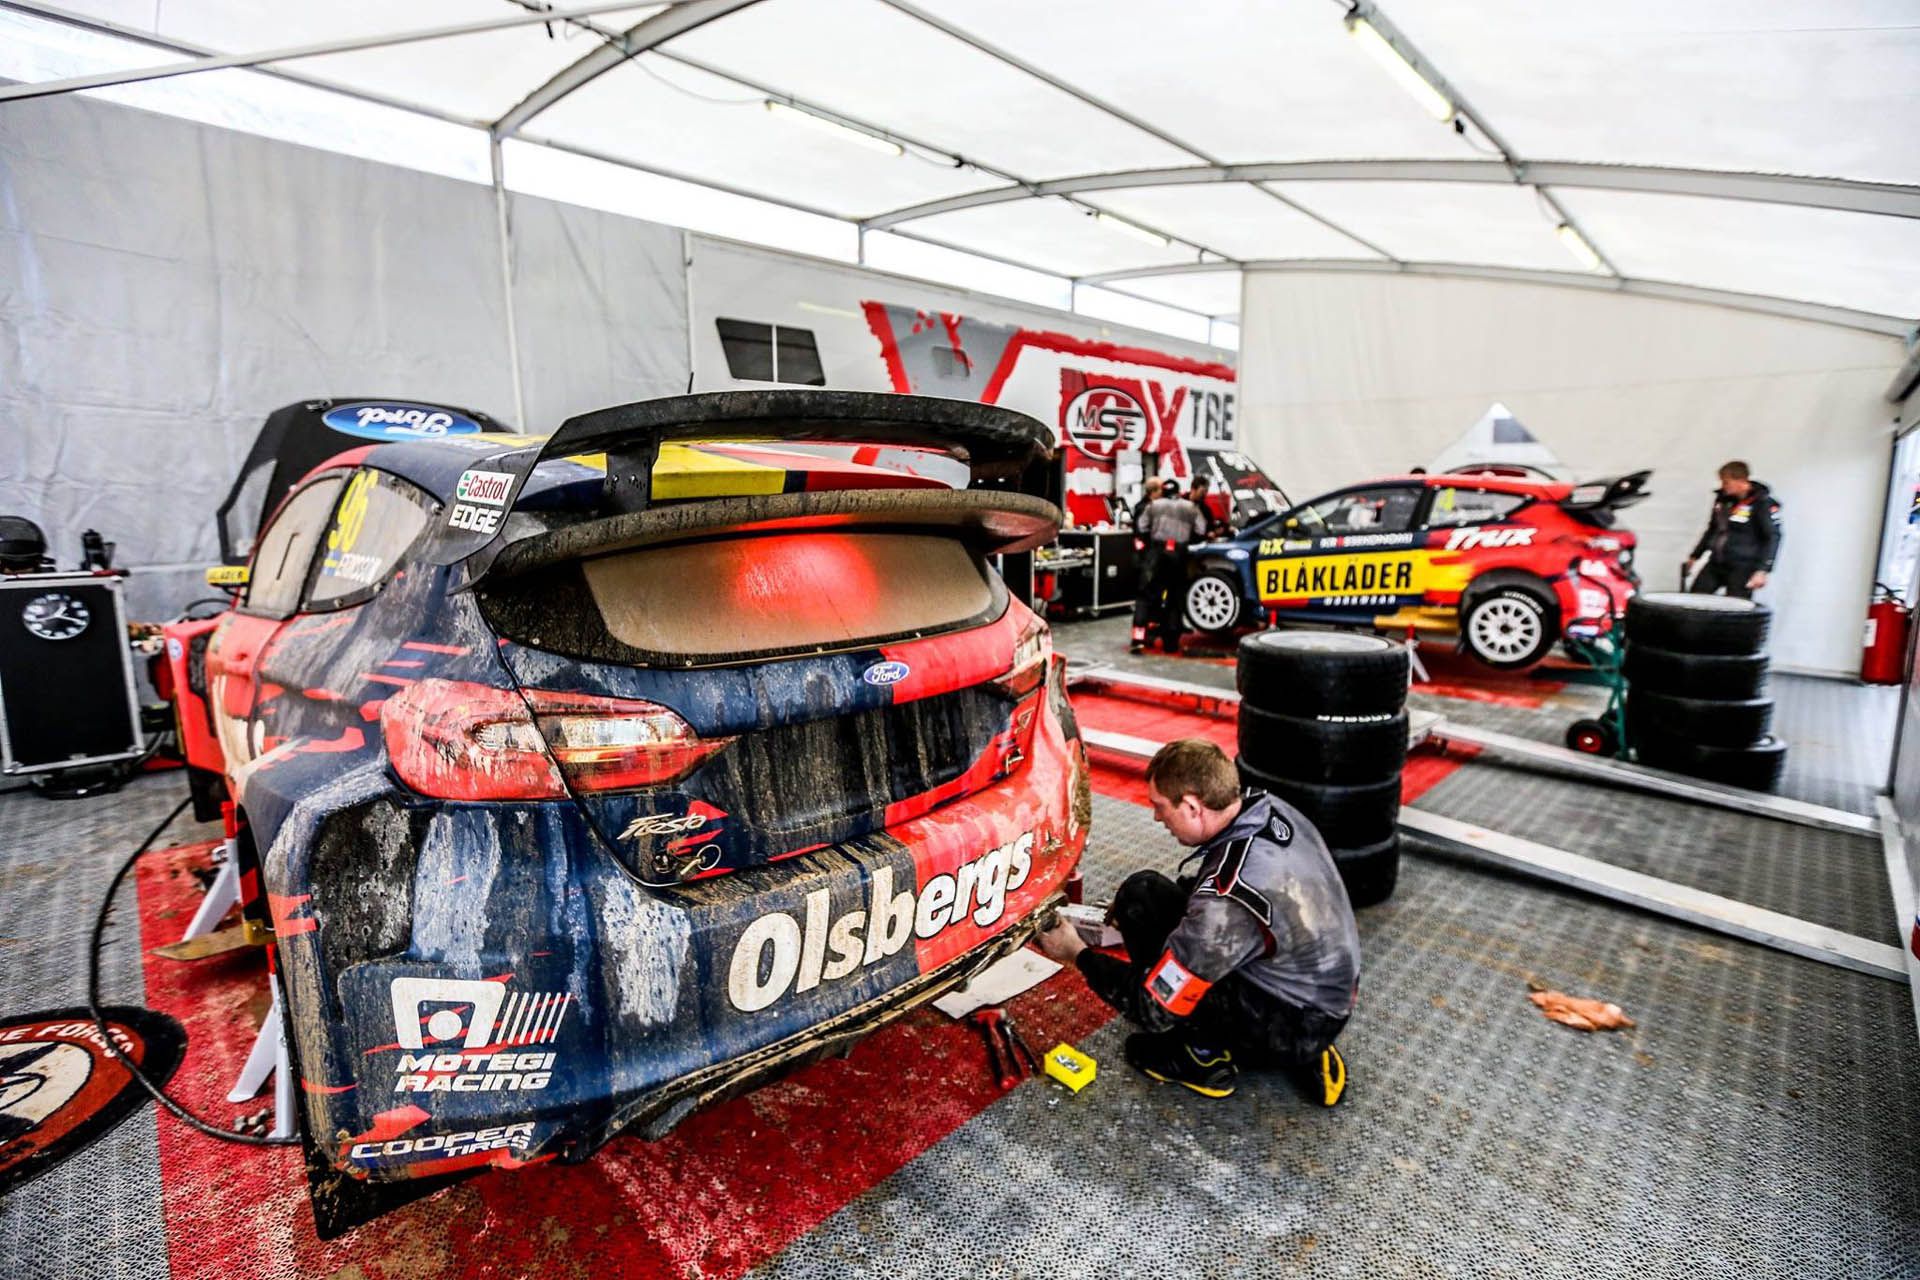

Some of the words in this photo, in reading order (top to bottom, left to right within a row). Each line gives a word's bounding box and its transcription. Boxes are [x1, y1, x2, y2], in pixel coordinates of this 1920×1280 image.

[356, 406, 454, 437] Ford
[1073, 405, 1145, 442] MSE
[468, 475, 508, 501] Castrol
[449, 504, 502, 534] EDGE
[1266, 557, 1412, 594] BLÅKLÄDER
[870, 664, 902, 683] Ford
[617, 812, 708, 840] Fiesta
[728, 832, 1033, 1012] Olsbergs
[395, 1052, 557, 1073] MOTEGI
[394, 1071, 552, 1093] RACING
[351, 1121, 536, 1159] COOPER
[443, 1136, 532, 1158] TIRES
